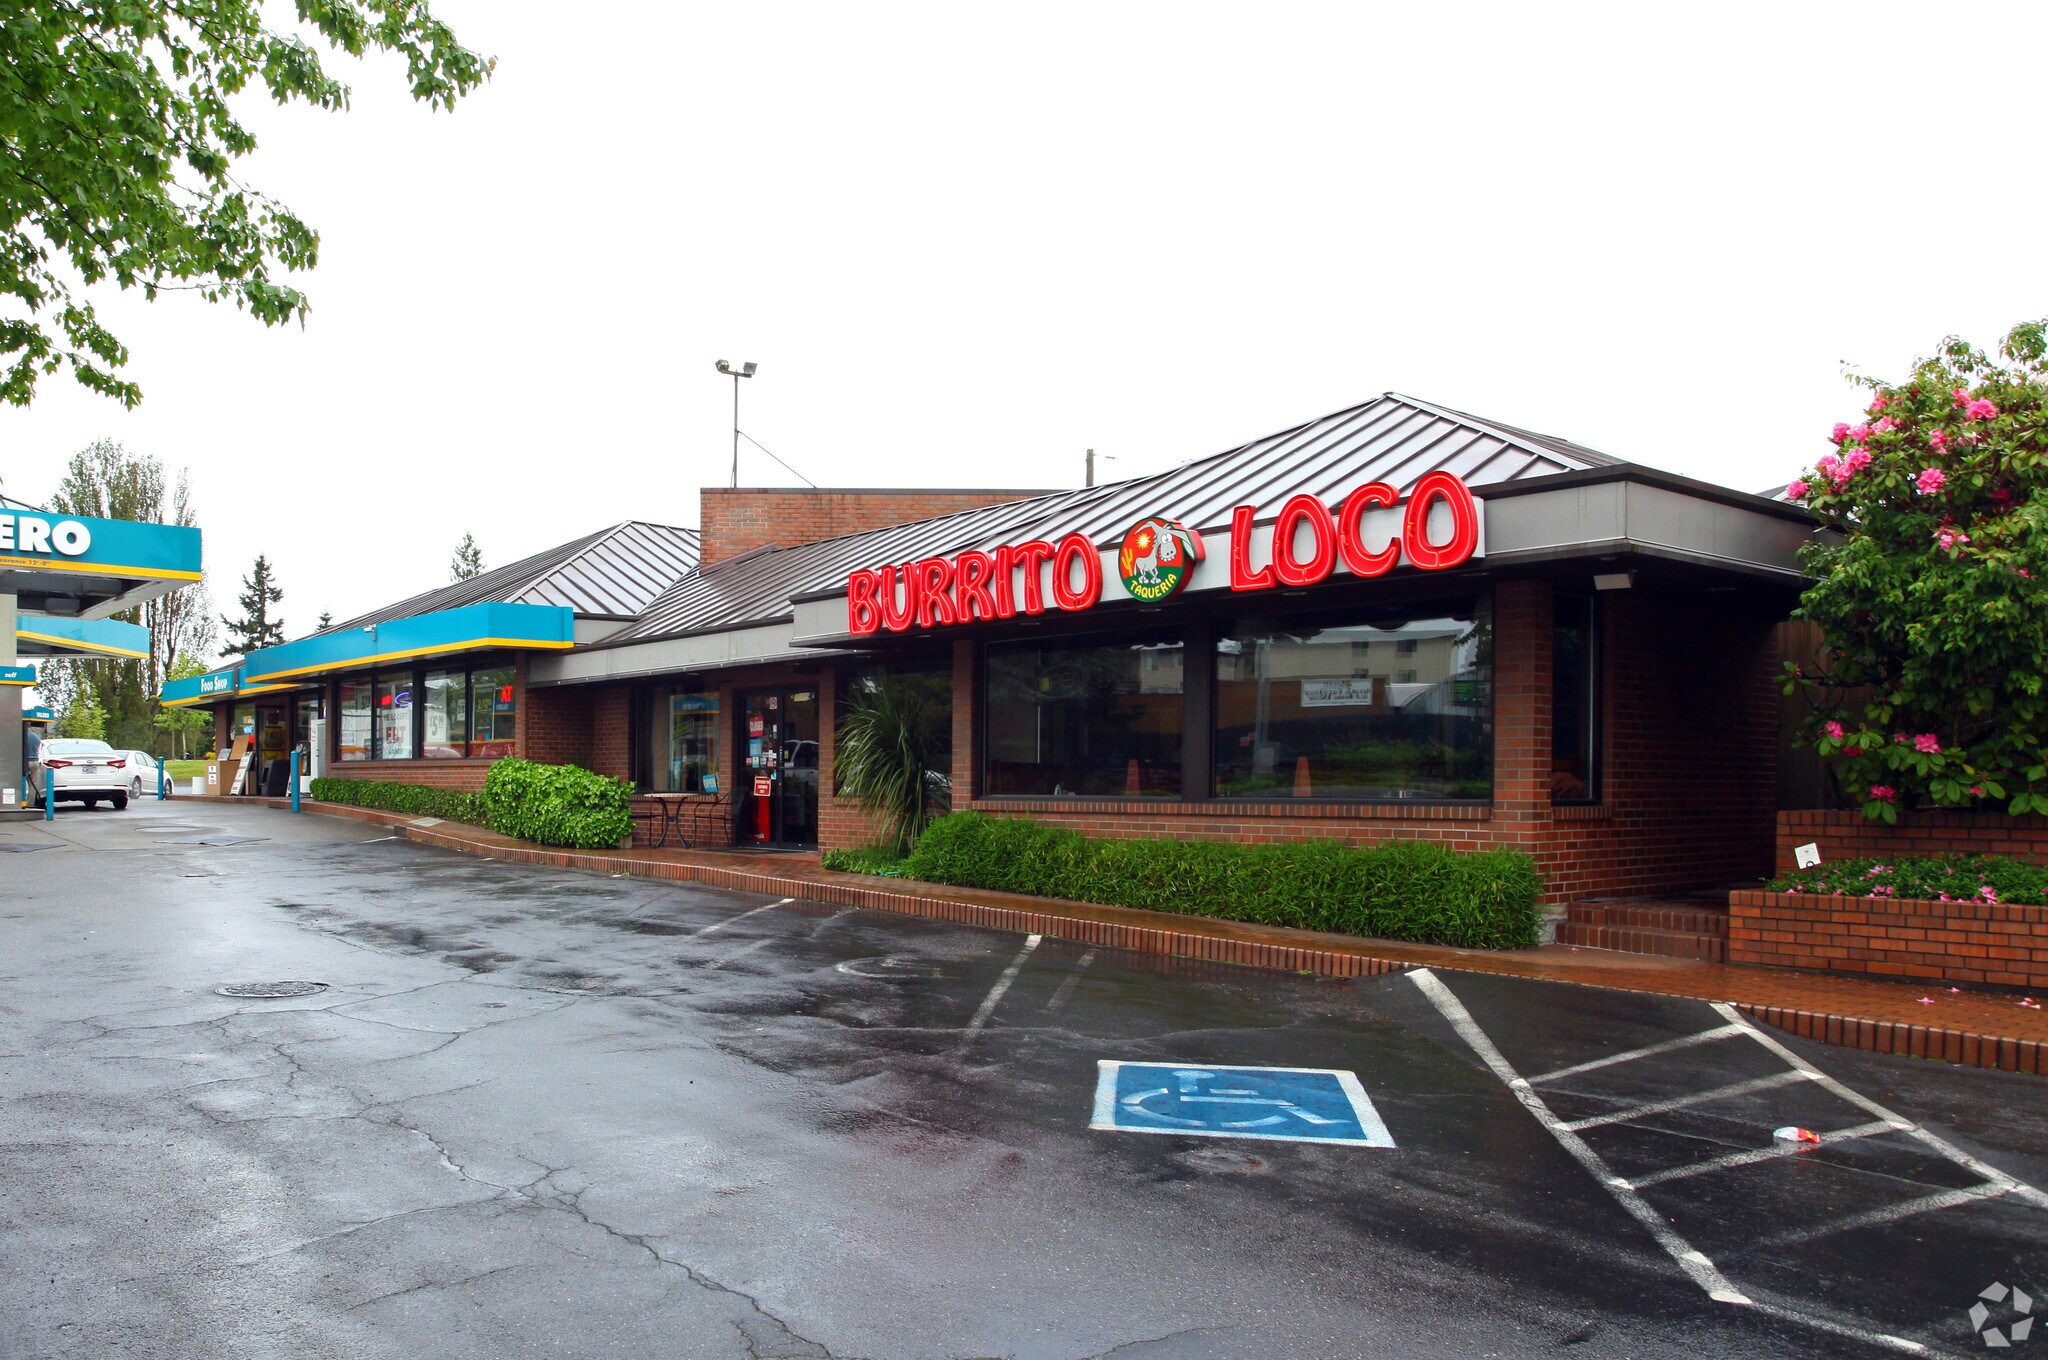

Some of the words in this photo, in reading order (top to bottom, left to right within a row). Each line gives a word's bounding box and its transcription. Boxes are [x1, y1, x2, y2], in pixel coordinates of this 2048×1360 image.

[0, 514, 91, 556] ERO
[848, 532, 1102, 636] BURRITO
[1230, 470, 1480, 592] LOCO
[1130, 573, 1177, 598] TAQUERIA
